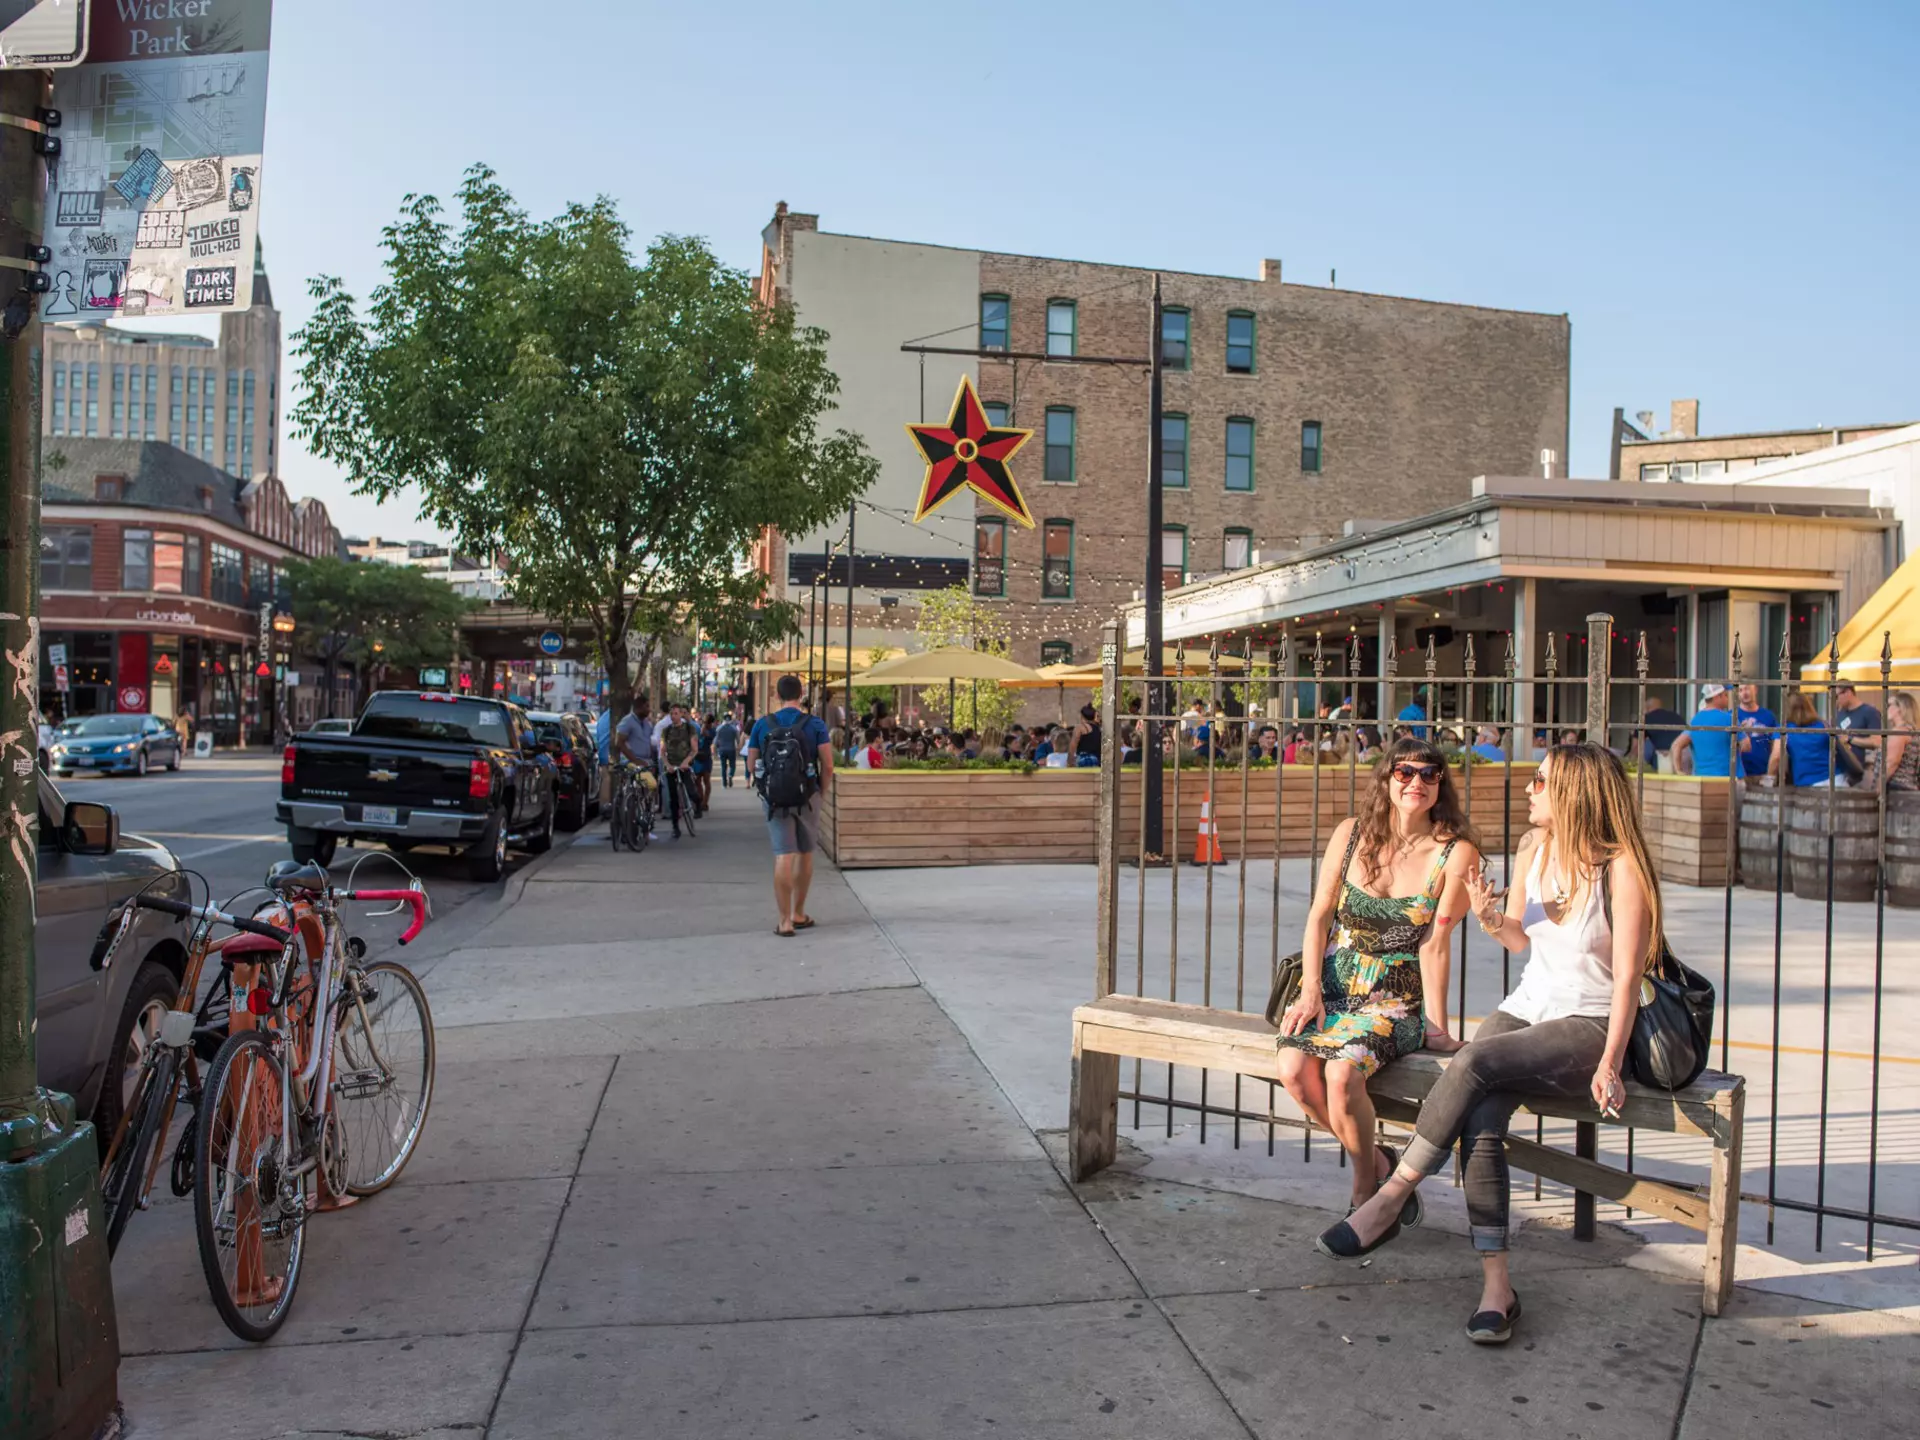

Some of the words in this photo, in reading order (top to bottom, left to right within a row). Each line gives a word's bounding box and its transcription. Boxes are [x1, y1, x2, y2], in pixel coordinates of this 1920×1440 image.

[115, 0, 212, 22] Wicker
[129, 26, 193, 56] Park
[60, 193, 100, 214] MUL
[138, 211, 184, 227] EDEM
[136, 226, 183, 242] ROME2
[194, 271, 231, 287] DARK
[186, 287, 234, 304] TIMES
